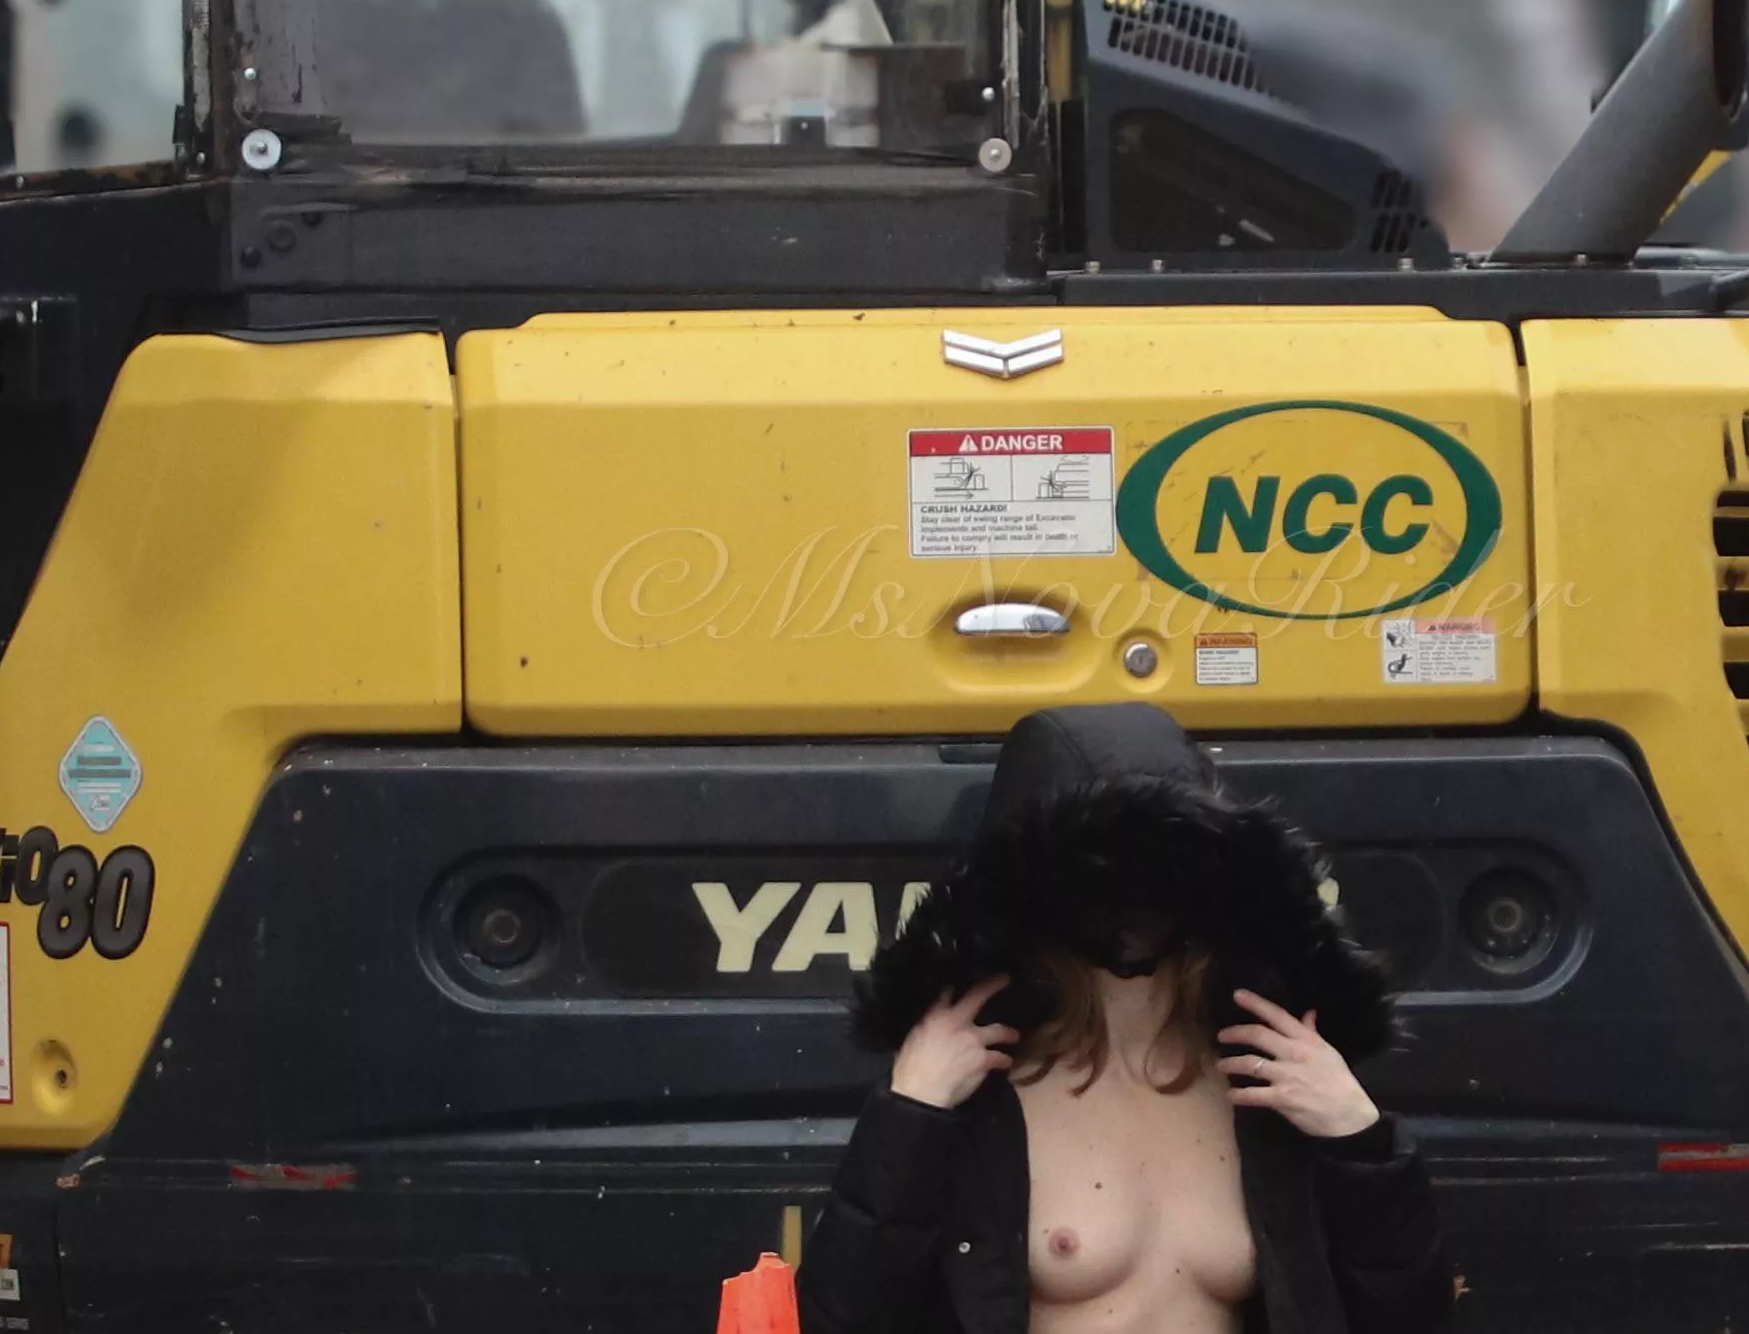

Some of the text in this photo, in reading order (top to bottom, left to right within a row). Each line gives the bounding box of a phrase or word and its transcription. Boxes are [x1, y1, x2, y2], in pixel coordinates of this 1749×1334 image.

[981, 434, 1063, 451] DANGER
[920, 504, 1007, 514] CRUSH HAZARD!
[1195, 473, 1433, 555] NCC
[920, 513, 1076, 525] Stay clear of swing range of Excavator
[920, 525, 969, 534] implements
[971, 524, 986, 532] and
[988, 524, 1023, 532] machine
[920, 534, 949, 542] Failure
[951, 534, 960, 542] to
[962, 534, 992, 544] comply
[994, 533, 1008, 542] will
[1010, 533, 1033, 541] result
[1034, 533, 1042, 541] in
[920, 544, 951, 552] serious
